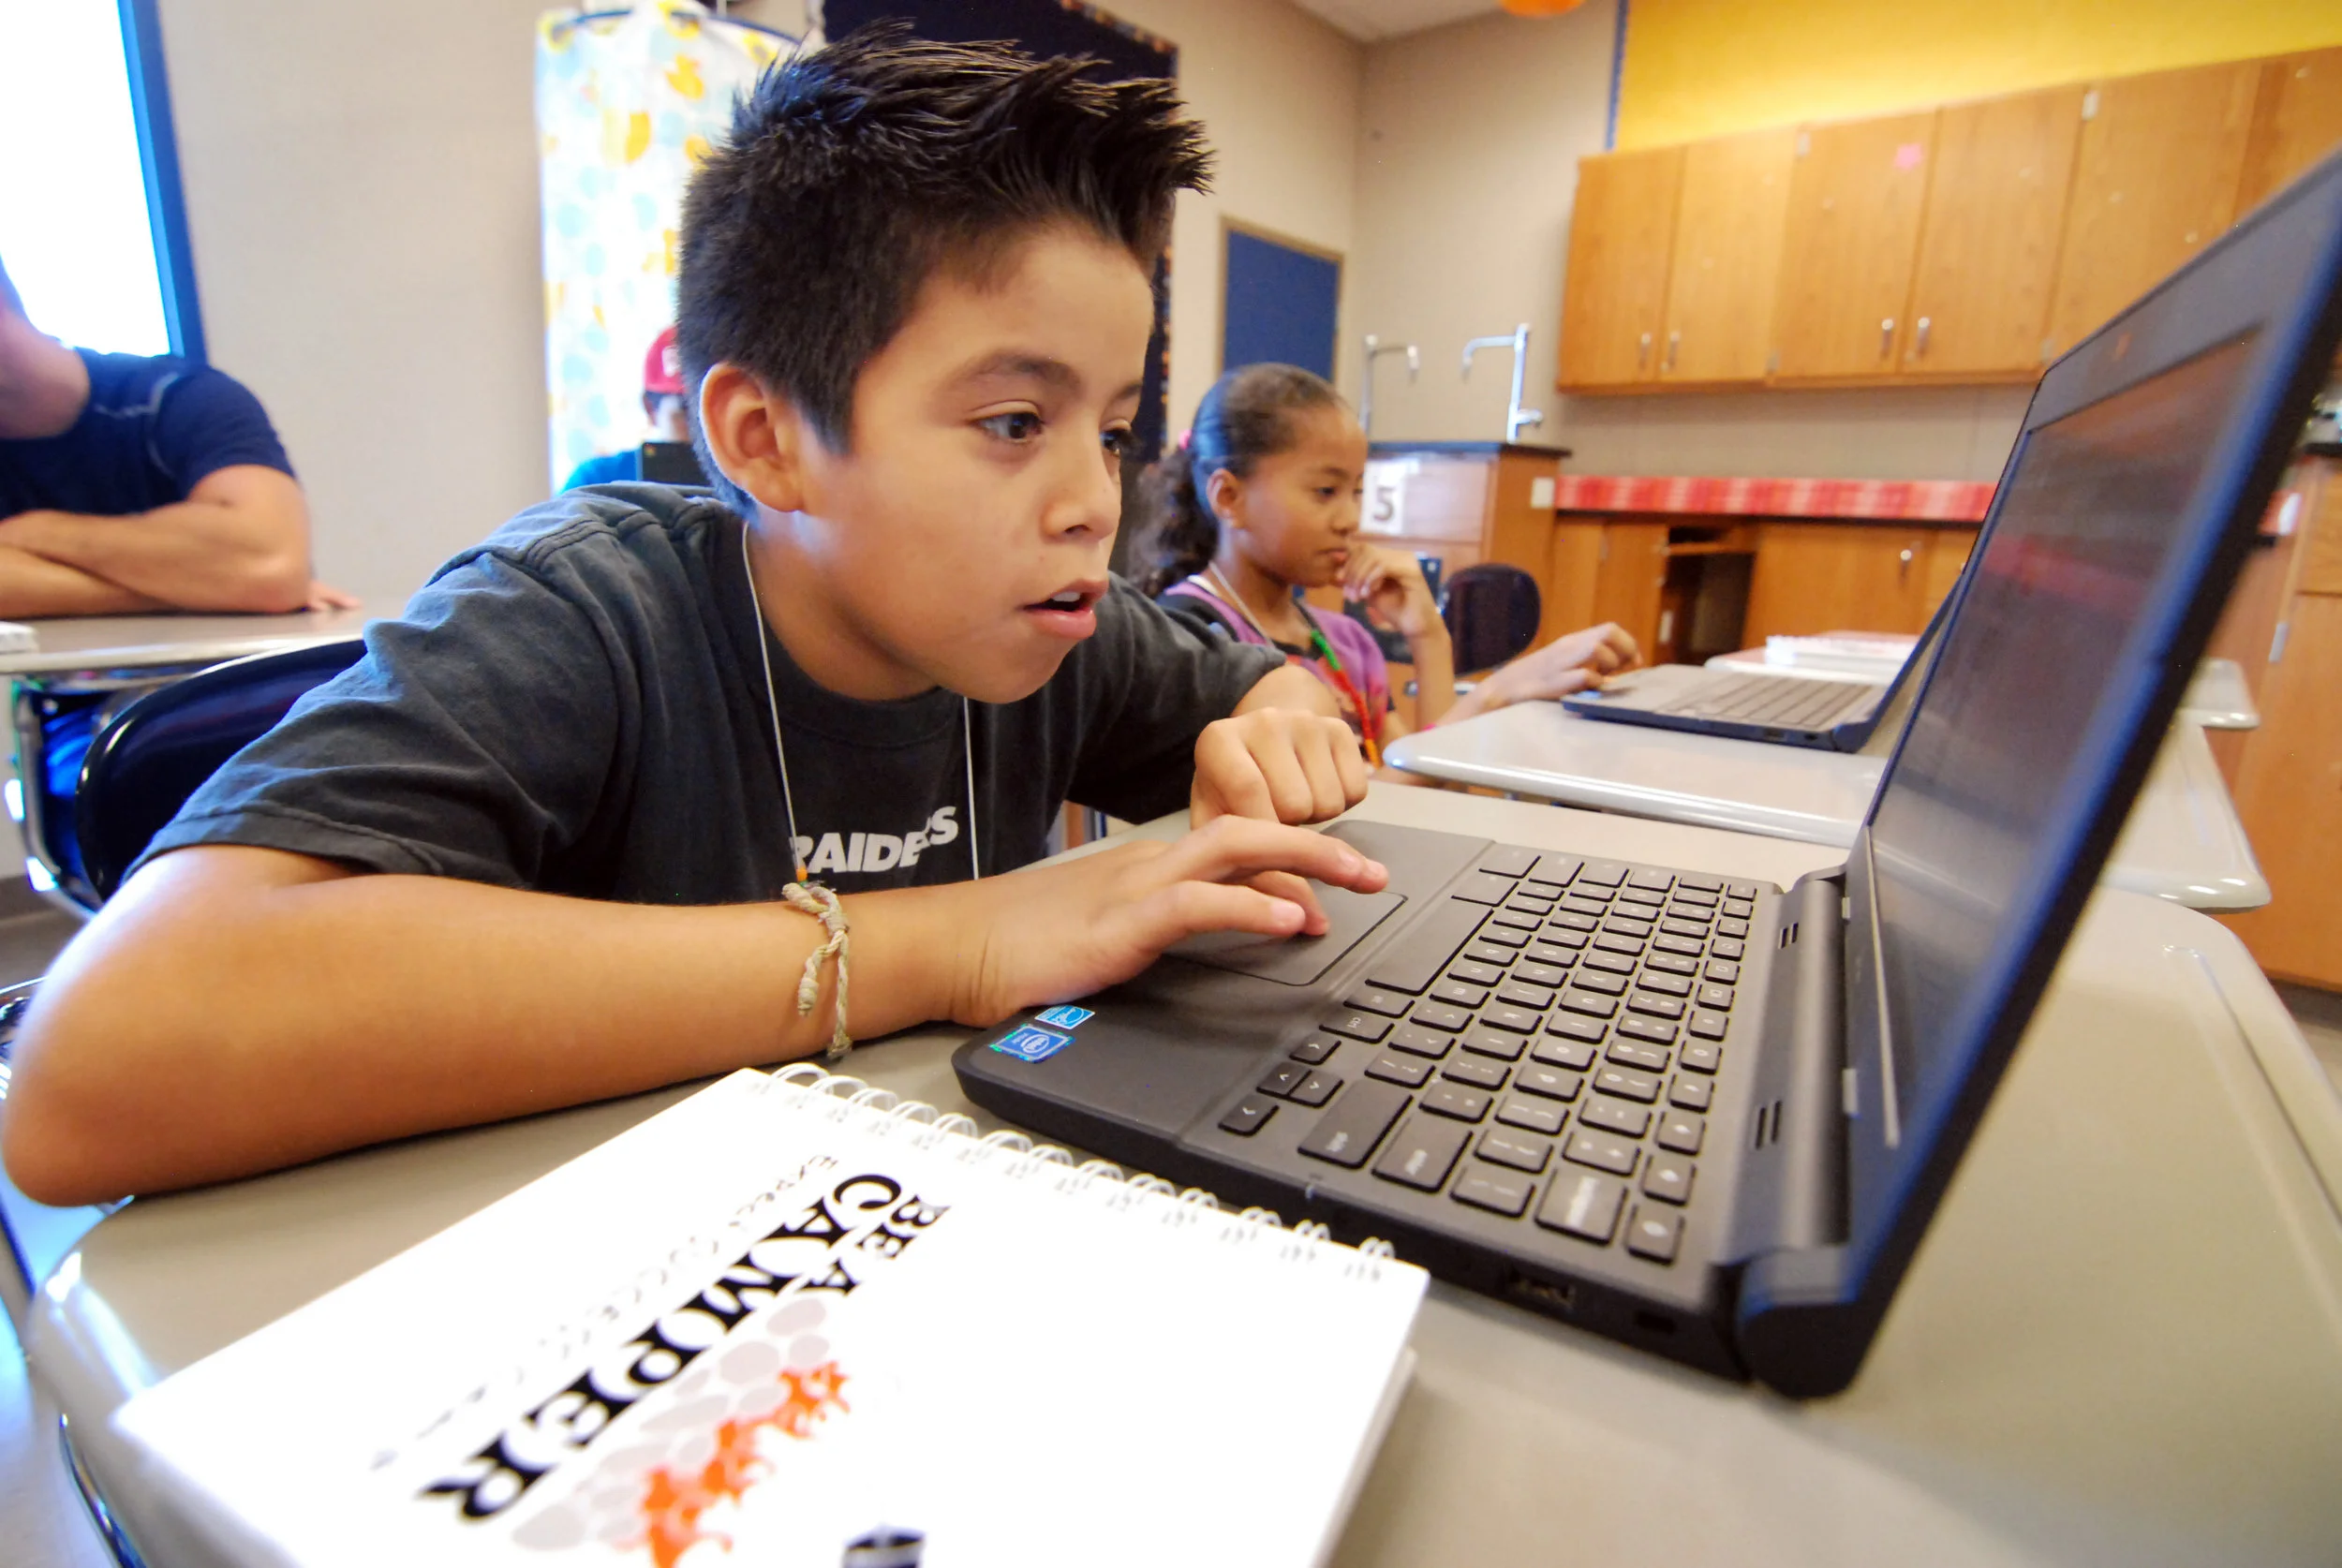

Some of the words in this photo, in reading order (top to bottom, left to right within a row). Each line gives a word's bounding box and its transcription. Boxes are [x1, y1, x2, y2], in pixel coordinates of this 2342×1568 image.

[1373, 485, 1397, 523] 5
[854, 1194, 951, 1260] BE
[794, 1257, 862, 1296] A
[416, 1173, 902, 1523] CAMPER
